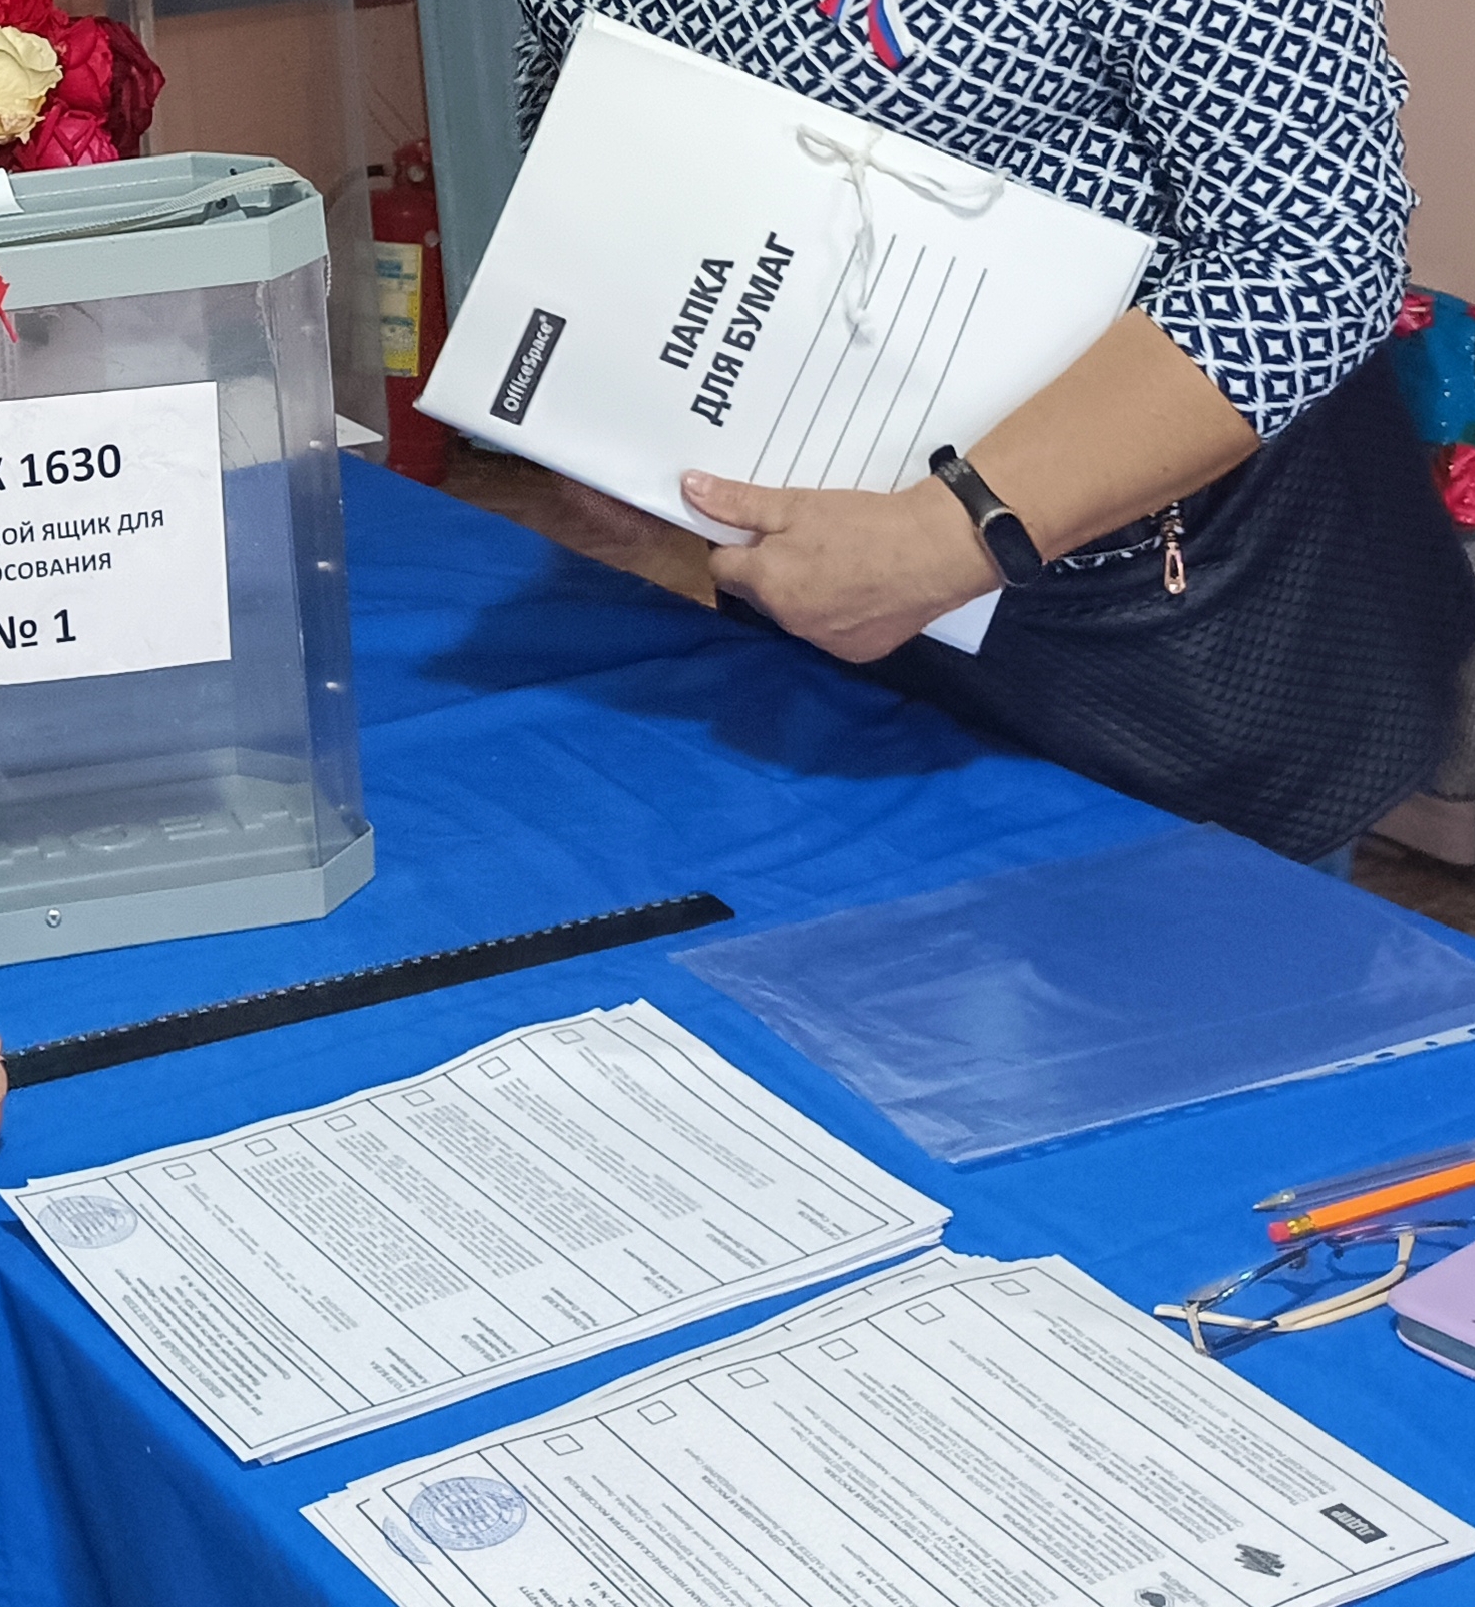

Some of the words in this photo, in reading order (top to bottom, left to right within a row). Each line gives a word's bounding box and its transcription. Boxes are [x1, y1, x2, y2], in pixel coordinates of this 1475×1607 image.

[660, 259, 734, 369] ПАПКА
[691, 352, 743, 427] ДЛЯ
[723, 232, 794, 351] БУМАГ
[20, 444, 121, 488] 1630
[42, 516, 111, 541] ЯЩИК
[118, 510, 164, 536] ДЛЯ
[53, 609, 77, 644] 1
